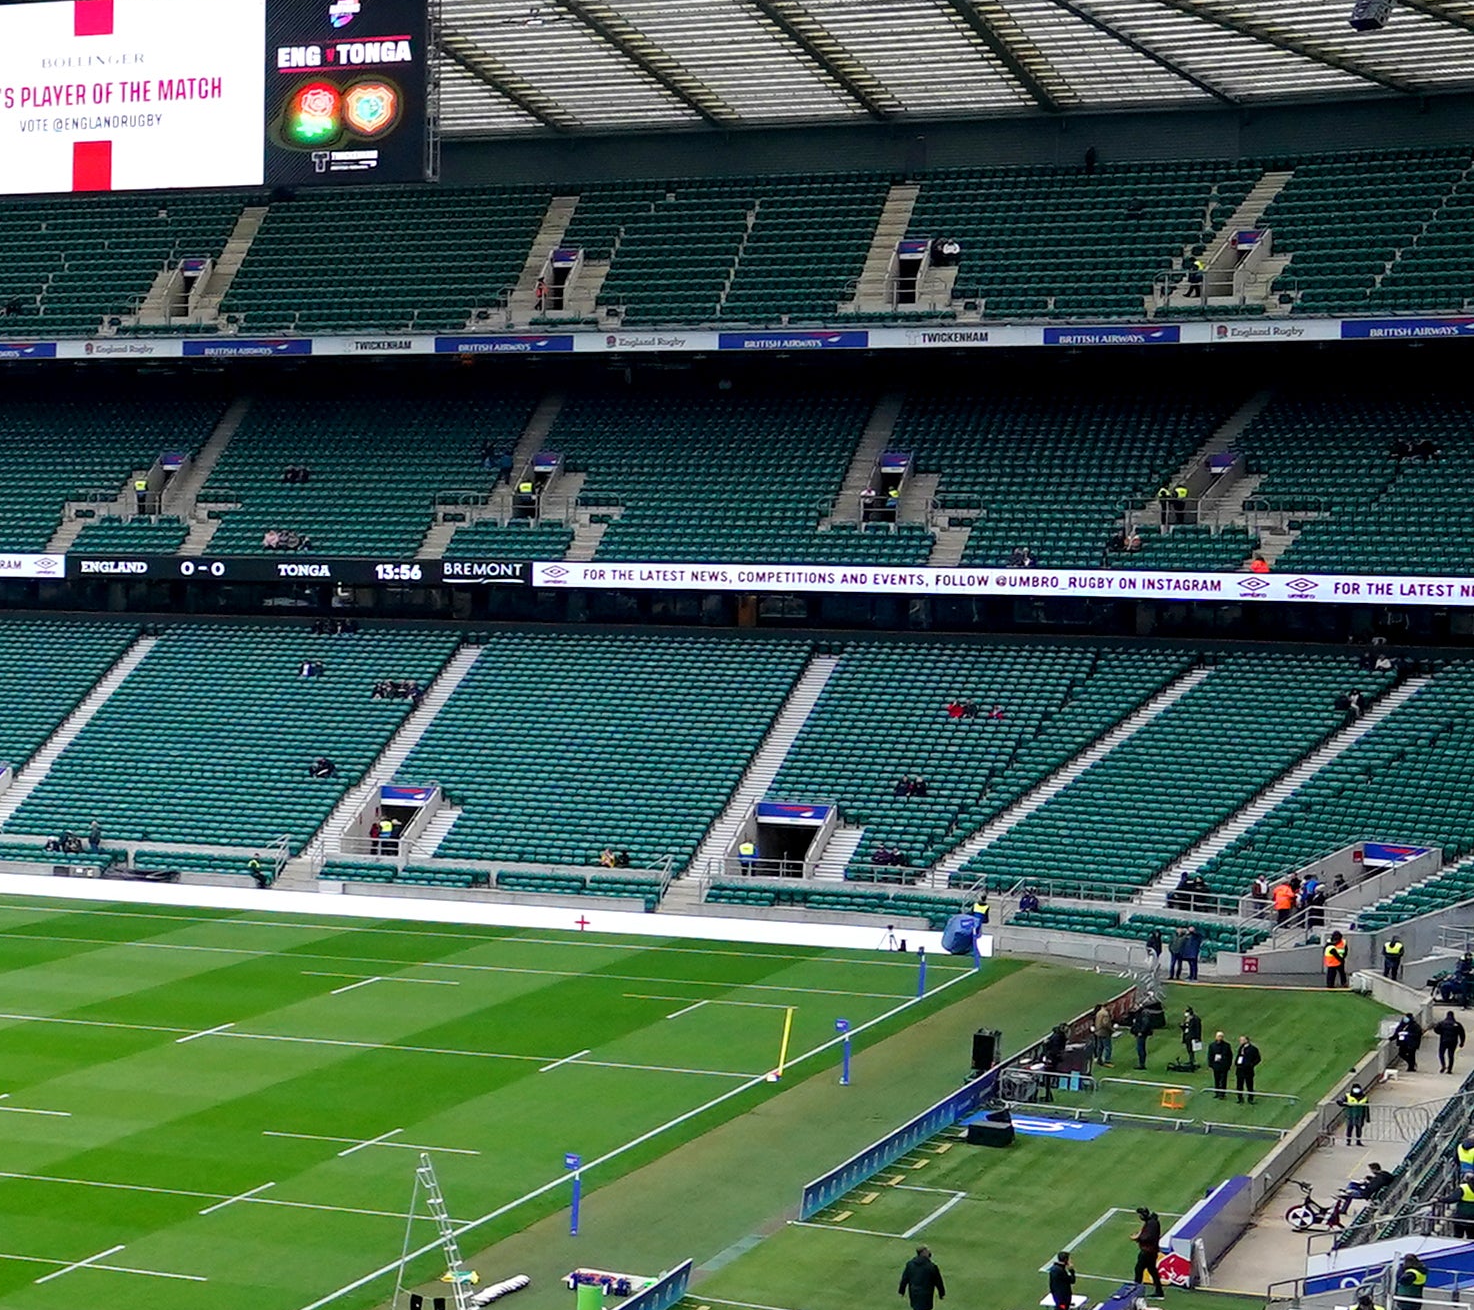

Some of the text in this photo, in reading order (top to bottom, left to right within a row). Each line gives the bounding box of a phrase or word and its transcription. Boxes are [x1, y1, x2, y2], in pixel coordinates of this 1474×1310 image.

[42, 53, 145, 69] BOLLINGER
[277, 46, 321, 69] ENG
[336, 41, 412, 65] TONGA
[21, 83, 86, 108] PLAYER
[93, 81, 113, 104] OF
[119, 80, 151, 103] THE
[158, 77, 222, 101] MATCH
[19, 113, 163, 132] VOTE @ENGLANDRUGBY
[922, 333, 988, 342] TWICKENHAM
[1230, 327, 1304, 337] England Rugby
[1370, 326, 1459, 337] BRITISH AIRWAYS
[1058, 334, 1145, 345] BRITISH AIRWAYS
[80, 561, 148, 574] ENGLAND
[277, 564, 330, 577] TONGA
[375, 564, 422, 580] 13:56
[443, 562, 523, 578] BREMONT
[583, 569, 1222, 592] FOR THE LATEST NEWS, COMPETITIONS AND EVENTS, FOLLOW @UMBRO_RUGBY ON INSTAGRAM
[1334, 582, 1361, 595] FOR
[1366, 583, 1393, 596] THE
[1400, 583, 1454, 597] LATEST
